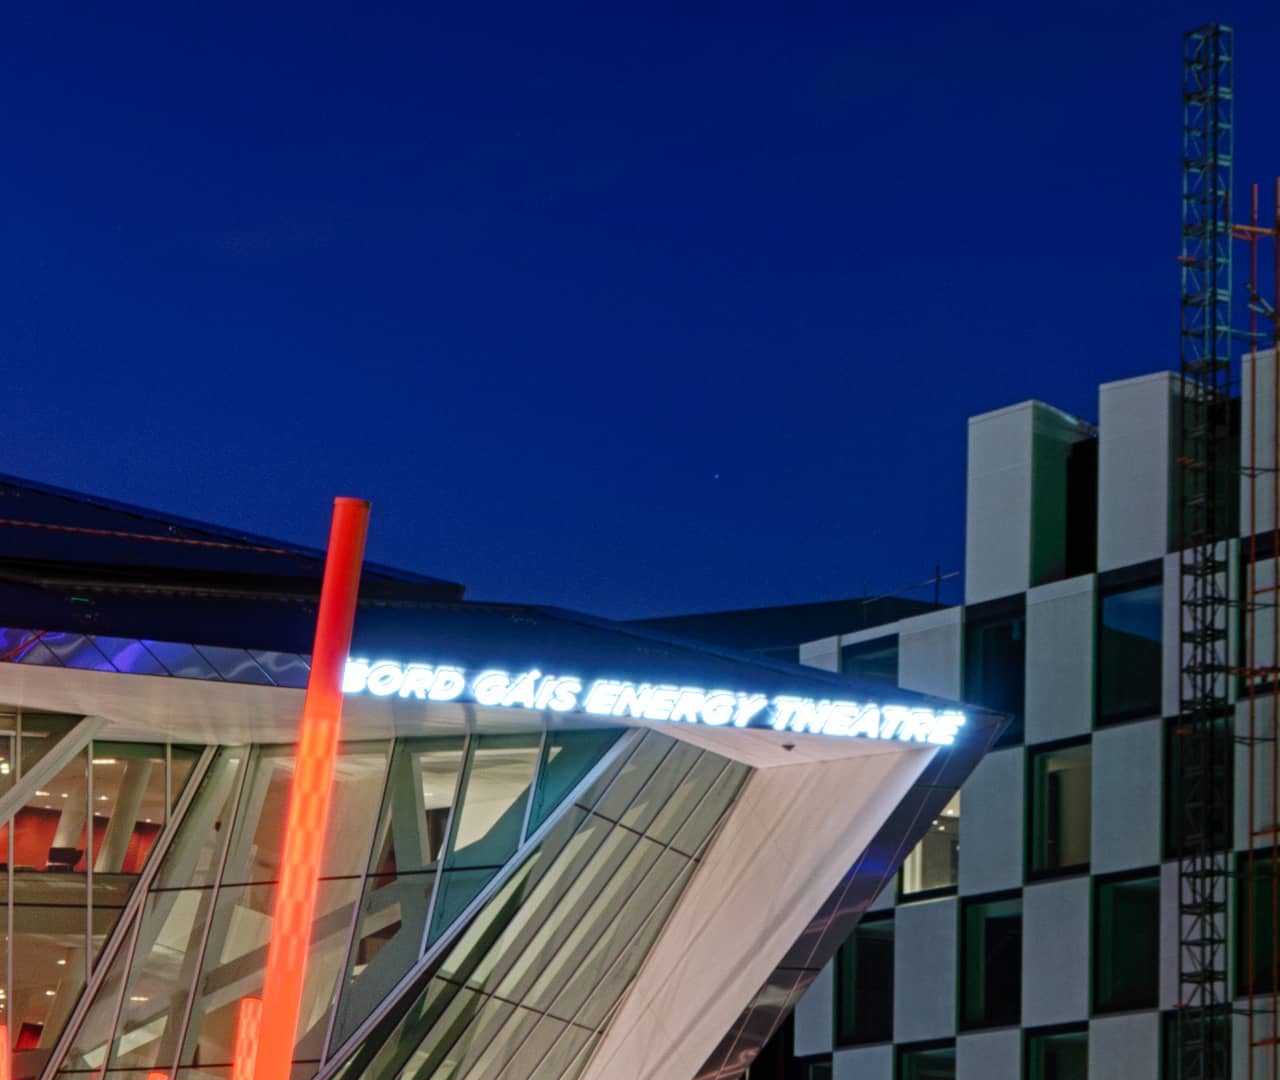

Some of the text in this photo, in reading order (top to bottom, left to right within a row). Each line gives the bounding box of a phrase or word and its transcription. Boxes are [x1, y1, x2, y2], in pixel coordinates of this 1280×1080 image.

[342, 658, 965, 745] BORD GÁIS ENERGY THEATRE
